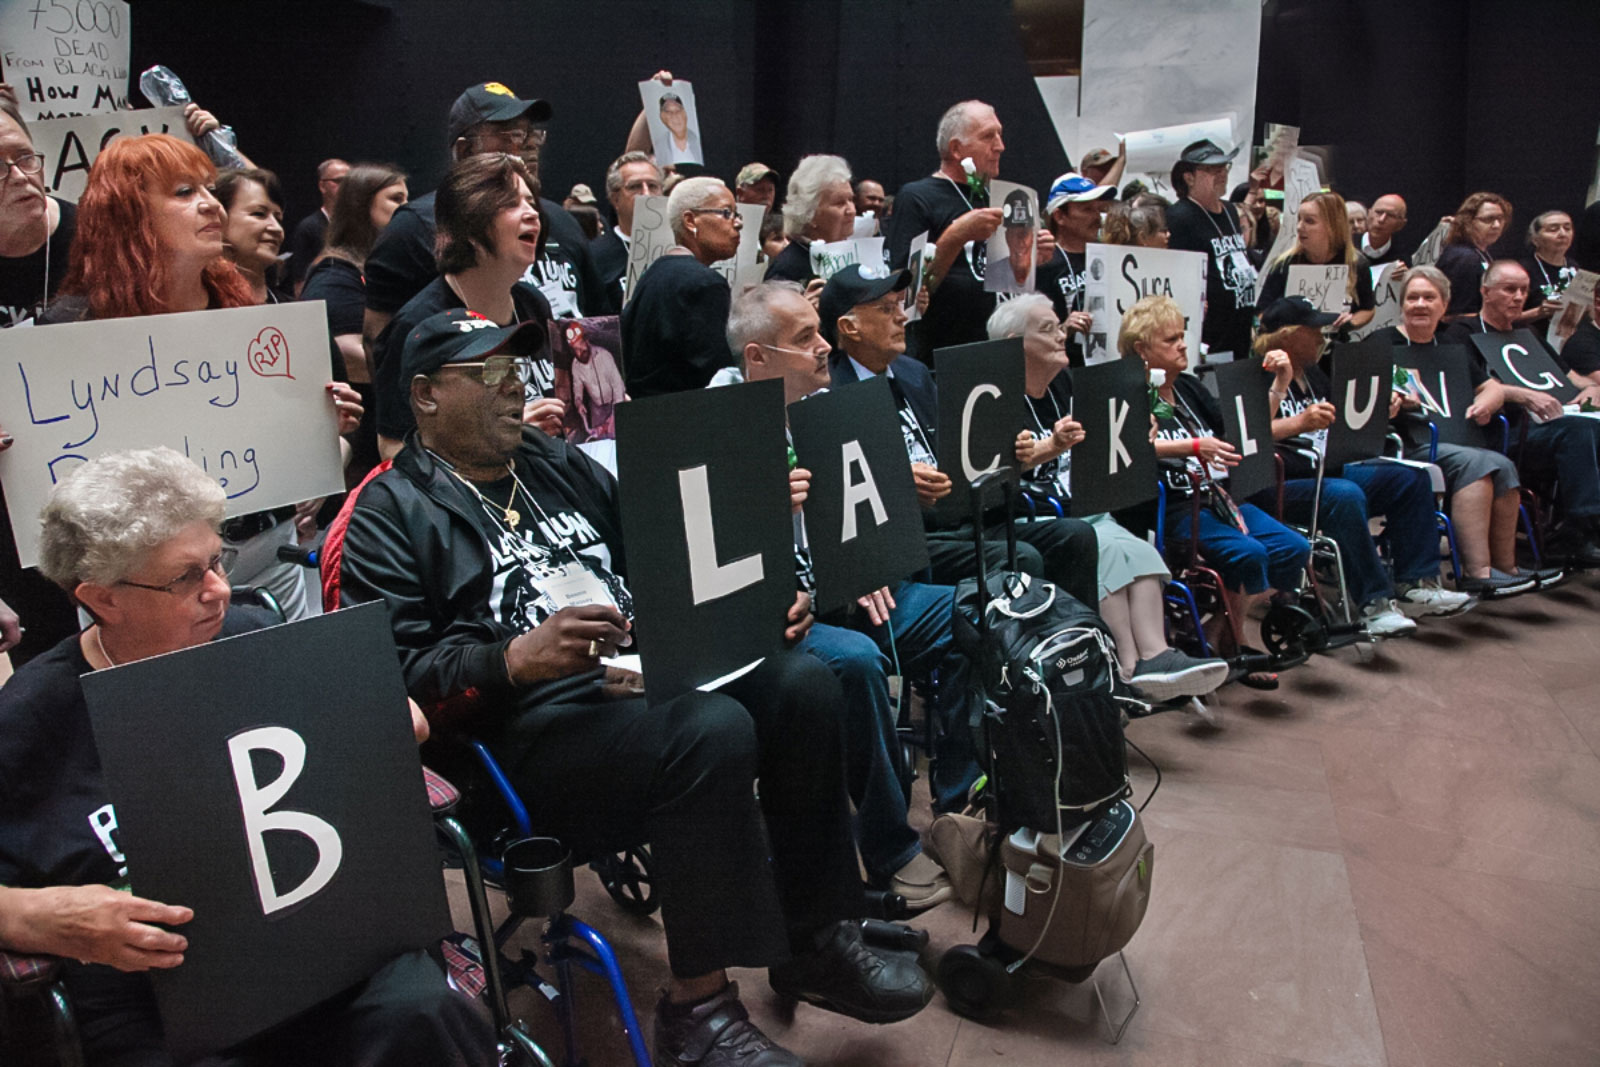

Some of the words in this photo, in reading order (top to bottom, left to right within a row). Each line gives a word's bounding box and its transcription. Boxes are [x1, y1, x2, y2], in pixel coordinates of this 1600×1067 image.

[54, 37, 109, 61] DEAD
[254, 333, 284, 372] RIP
[1501, 343, 1564, 390] G
[1235, 395, 1258, 457] L
[1344, 375, 1379, 430] U
[1419, 371, 1452, 419] N
[961, 384, 1002, 483] C
[1108, 397, 1133, 475] K
[841, 439, 889, 543] A
[678, 464, 765, 606] L
[228, 726, 343, 915] B
